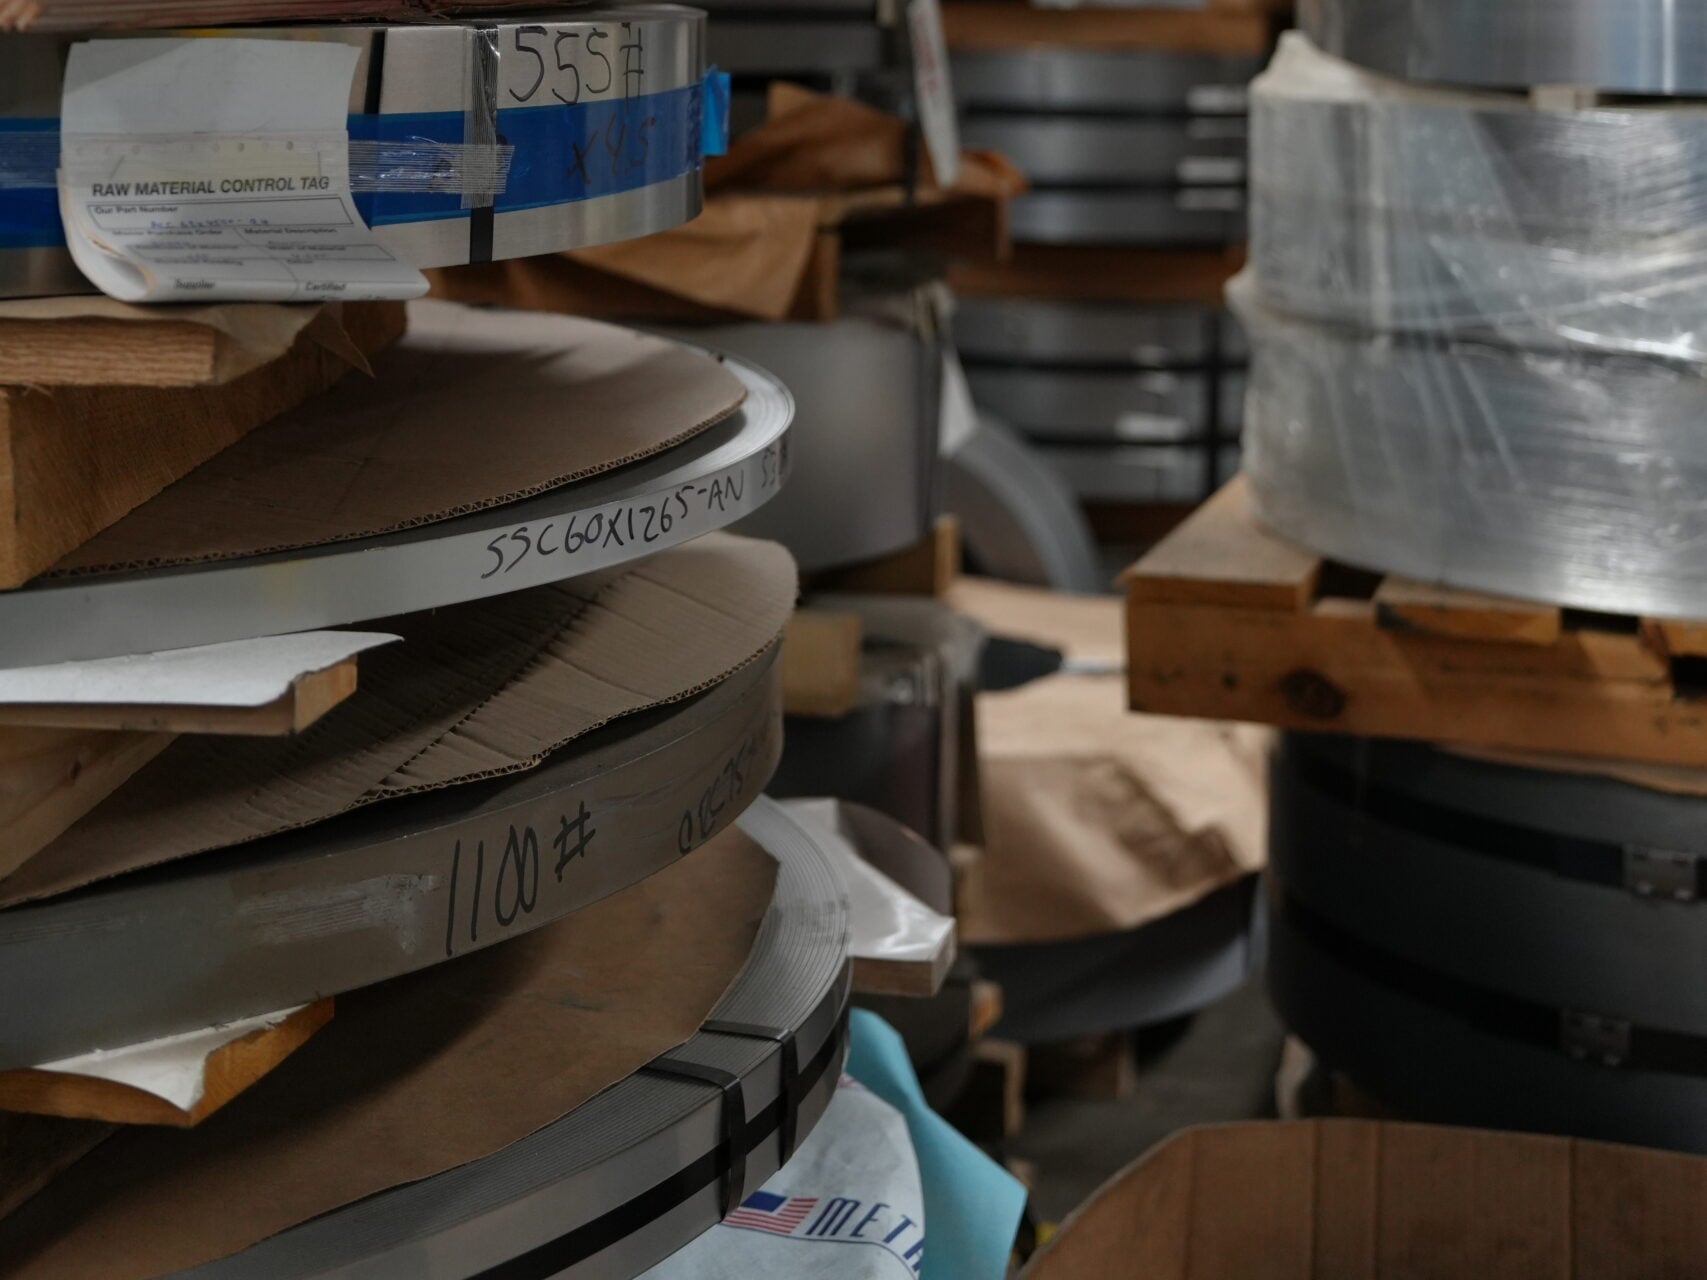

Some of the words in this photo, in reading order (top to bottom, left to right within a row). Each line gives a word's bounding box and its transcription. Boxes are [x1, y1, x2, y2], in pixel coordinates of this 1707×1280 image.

[92, 182, 128, 197] RAW
[134, 180, 215, 196] MATERIAL
[221, 177, 295, 194] CONTROL
[301, 176, 330, 191] TAG
[140, 205, 179, 214] Number
